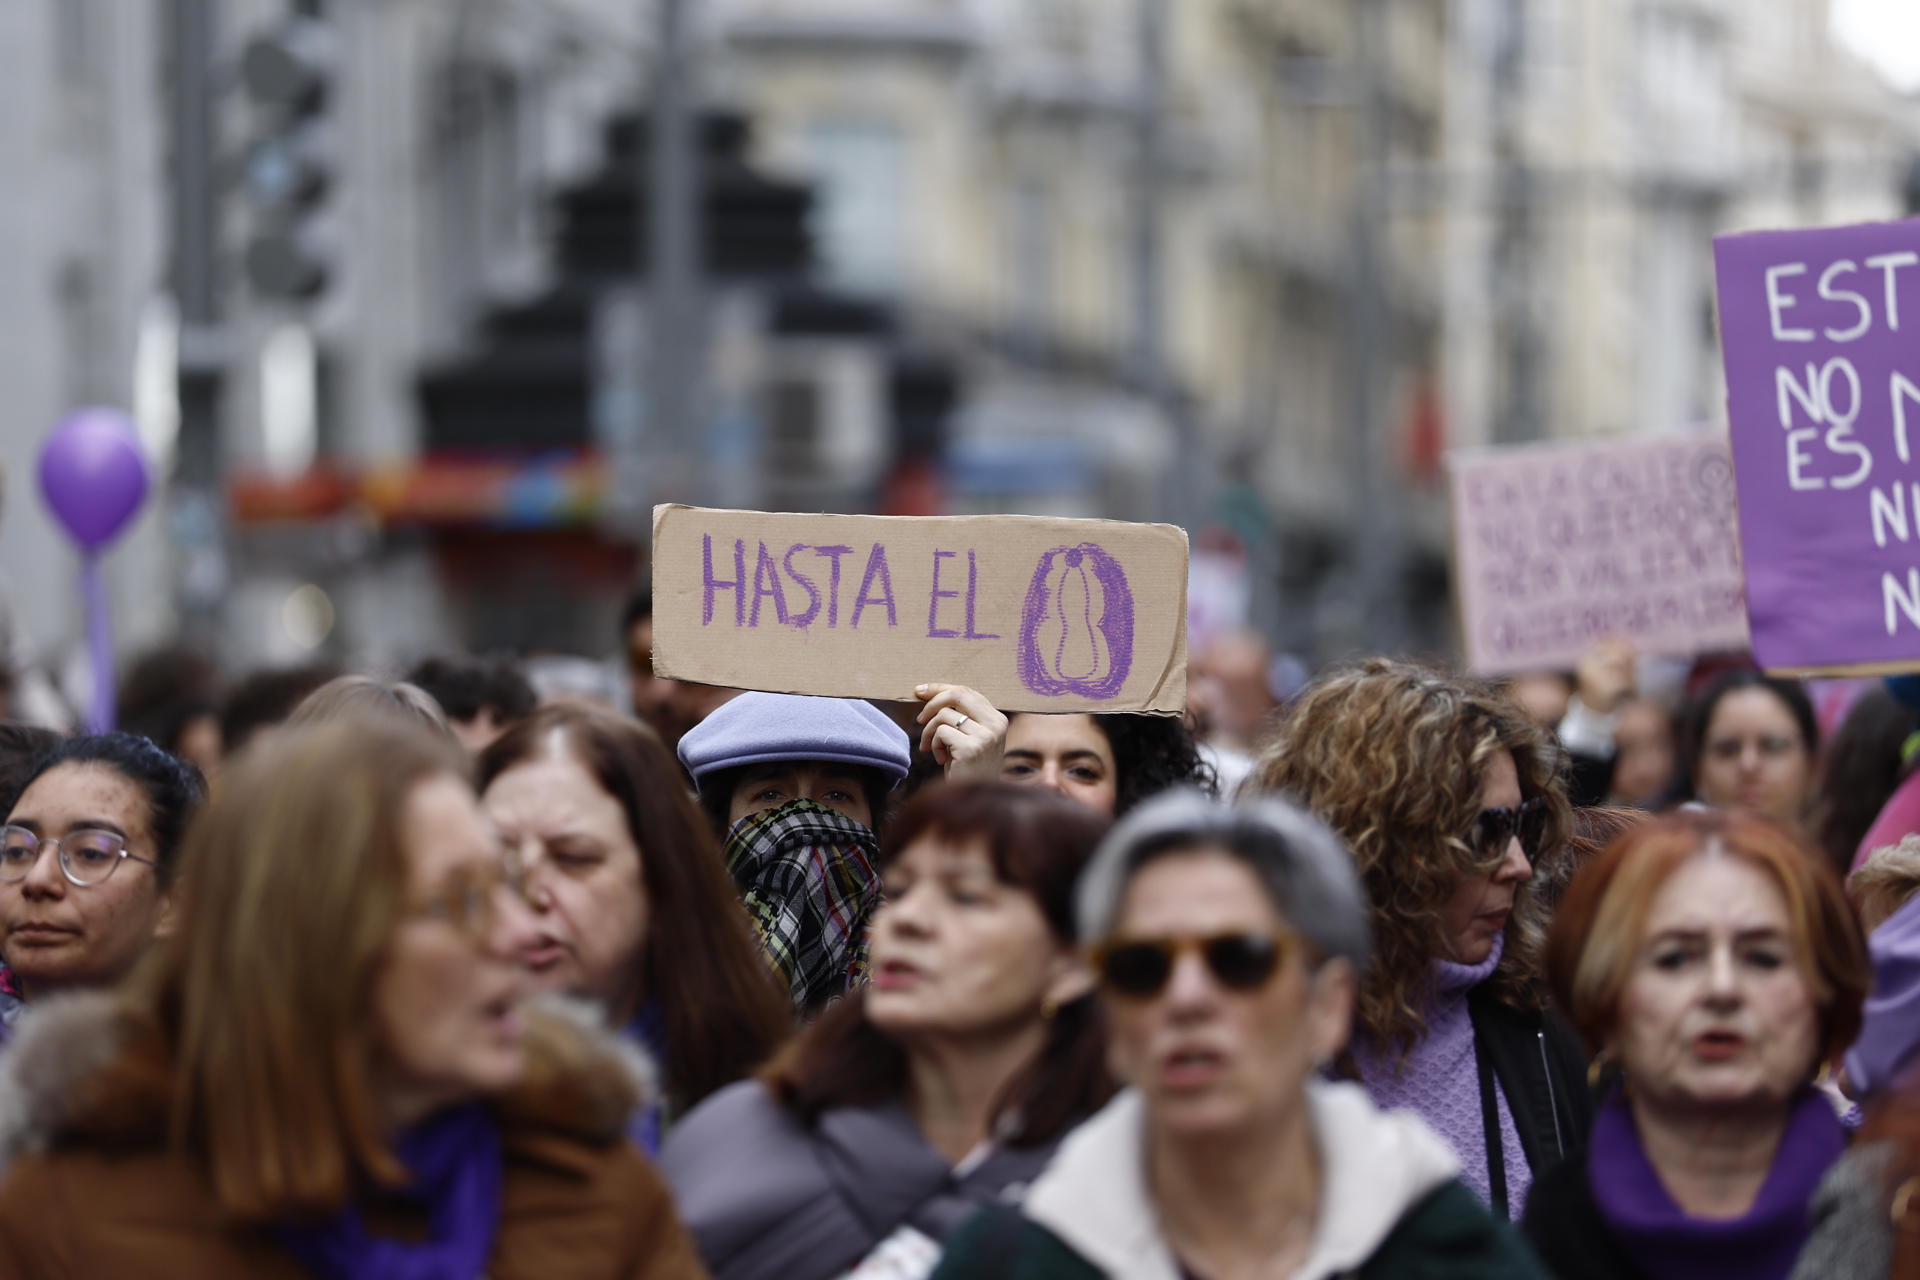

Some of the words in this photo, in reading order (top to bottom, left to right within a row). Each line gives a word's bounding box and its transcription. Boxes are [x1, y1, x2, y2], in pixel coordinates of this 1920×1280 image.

[1765, 251, 1920, 341] EST
[1775, 357, 1861, 430] NO
[1787, 425, 1873, 490] ES
[701, 532, 898, 632] HASTA
[925, 547, 1002, 639] EL
